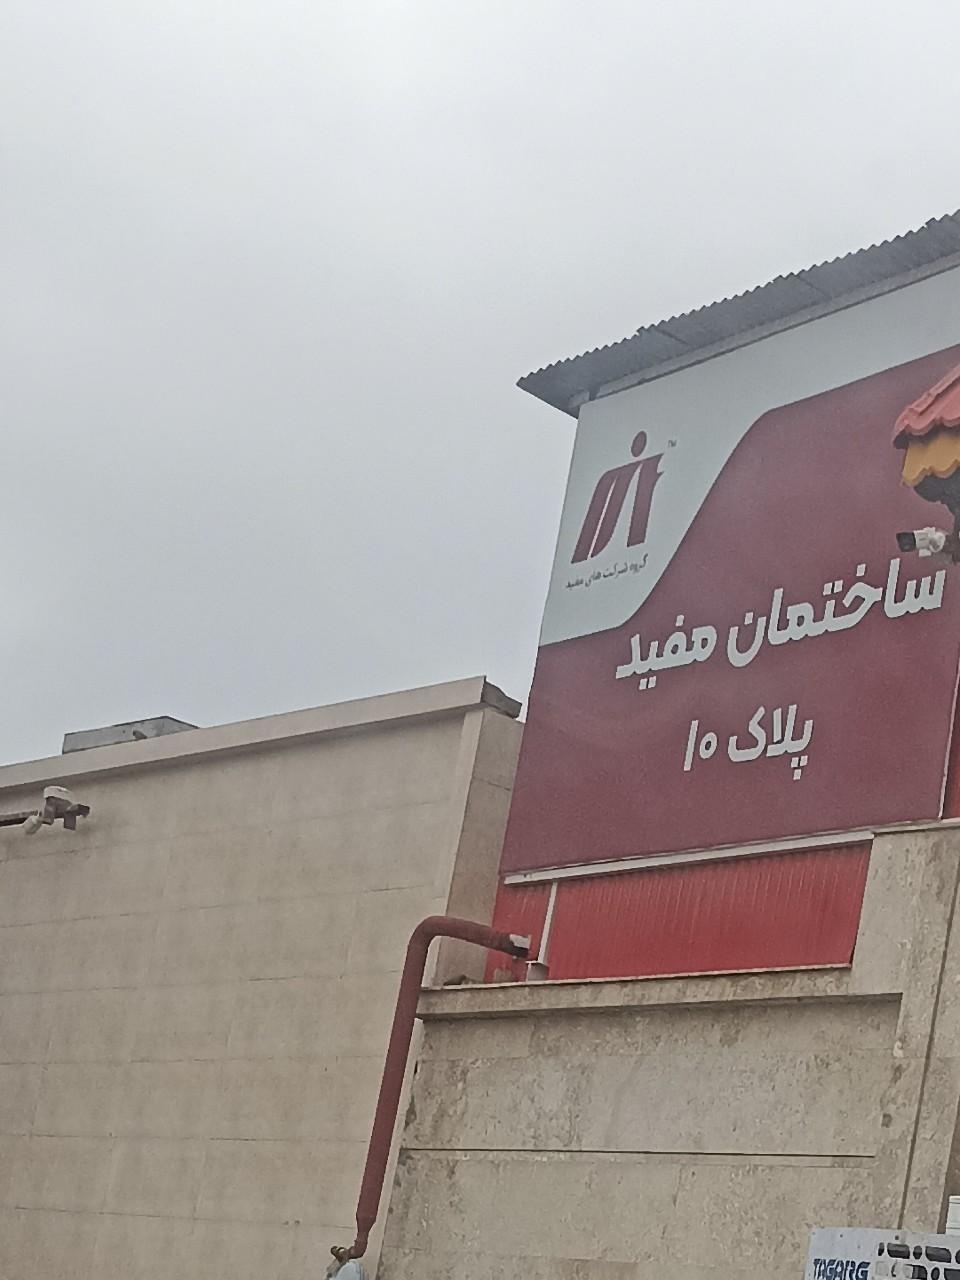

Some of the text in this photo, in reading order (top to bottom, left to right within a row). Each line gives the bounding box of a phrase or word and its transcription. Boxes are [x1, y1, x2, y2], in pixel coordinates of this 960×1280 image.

[615, 557, 946, 691] ساختمان مفید
[683, 703, 814, 781] پلاک ۱۰
